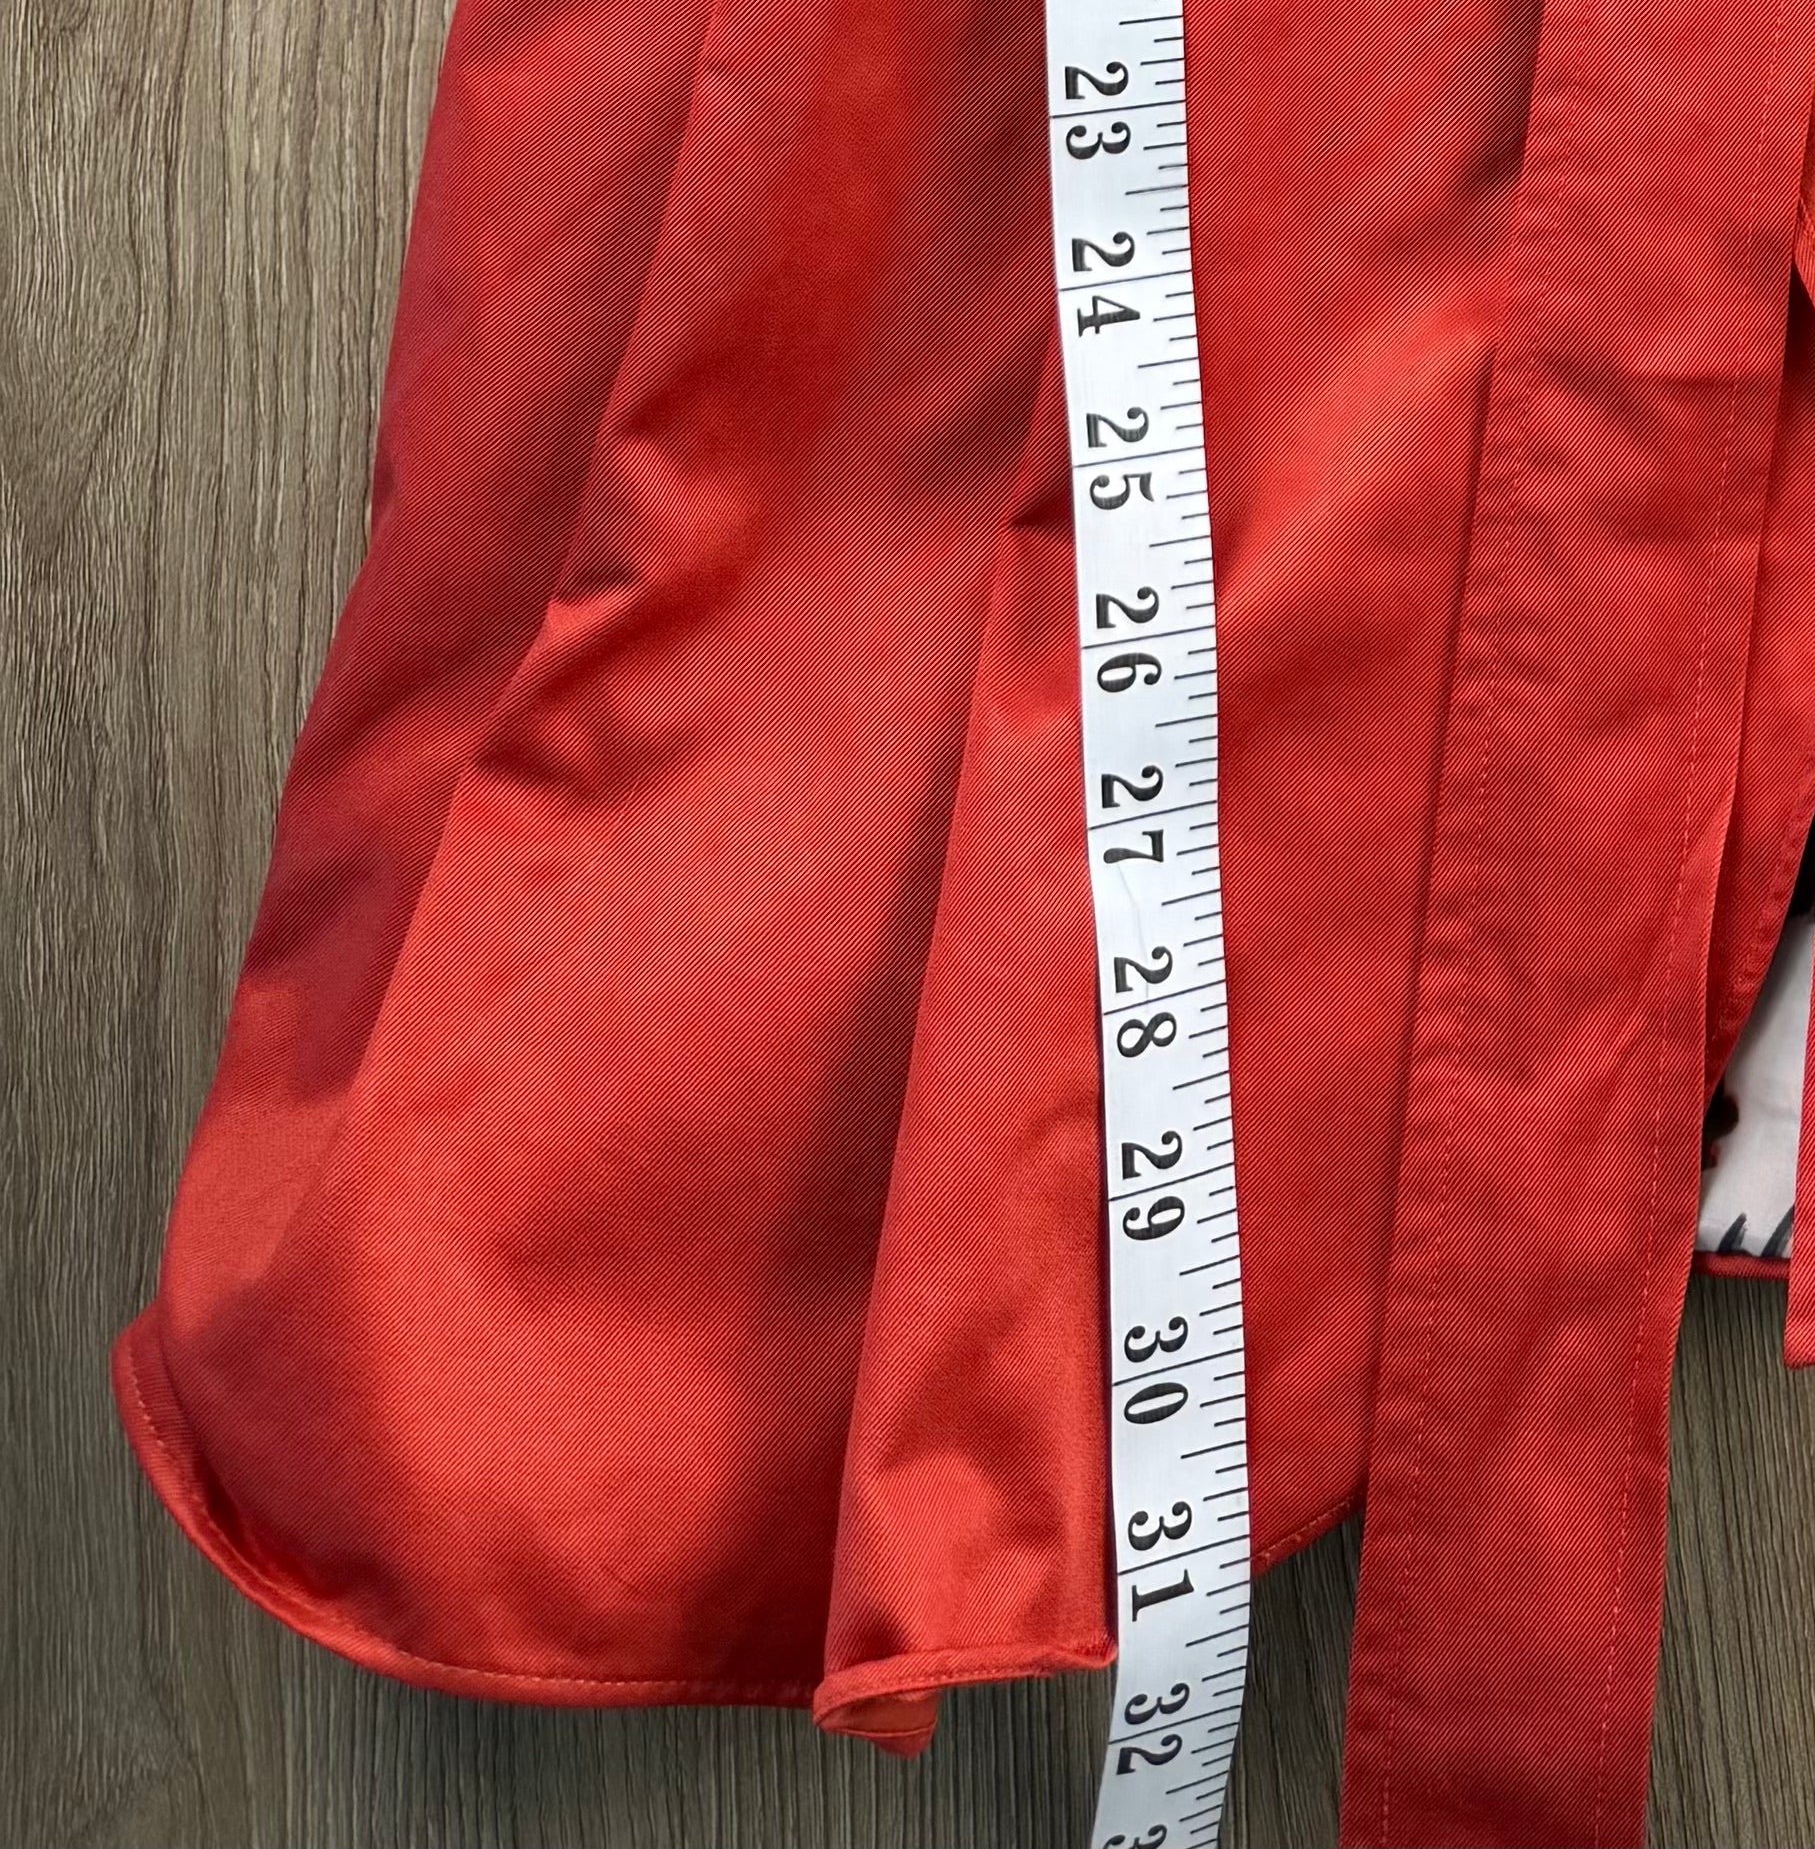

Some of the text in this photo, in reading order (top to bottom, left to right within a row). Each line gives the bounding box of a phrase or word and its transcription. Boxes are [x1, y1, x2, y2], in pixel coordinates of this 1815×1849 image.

[1064, 61, 1132, 160] 23
[1071, 231, 1141, 338] 24
[1085, 407, 1154, 511] 25
[1095, 586, 1162, 694] 26
[1100, 765, 1164, 864] 27
[1113, 946, 1177, 1058] 28
[1121, 1130, 1186, 1241] 29
[1123, 1316, 1189, 1425] 30
[1127, 1501, 1195, 1623] 31
[1115, 1682, 1190, 1776] 32
